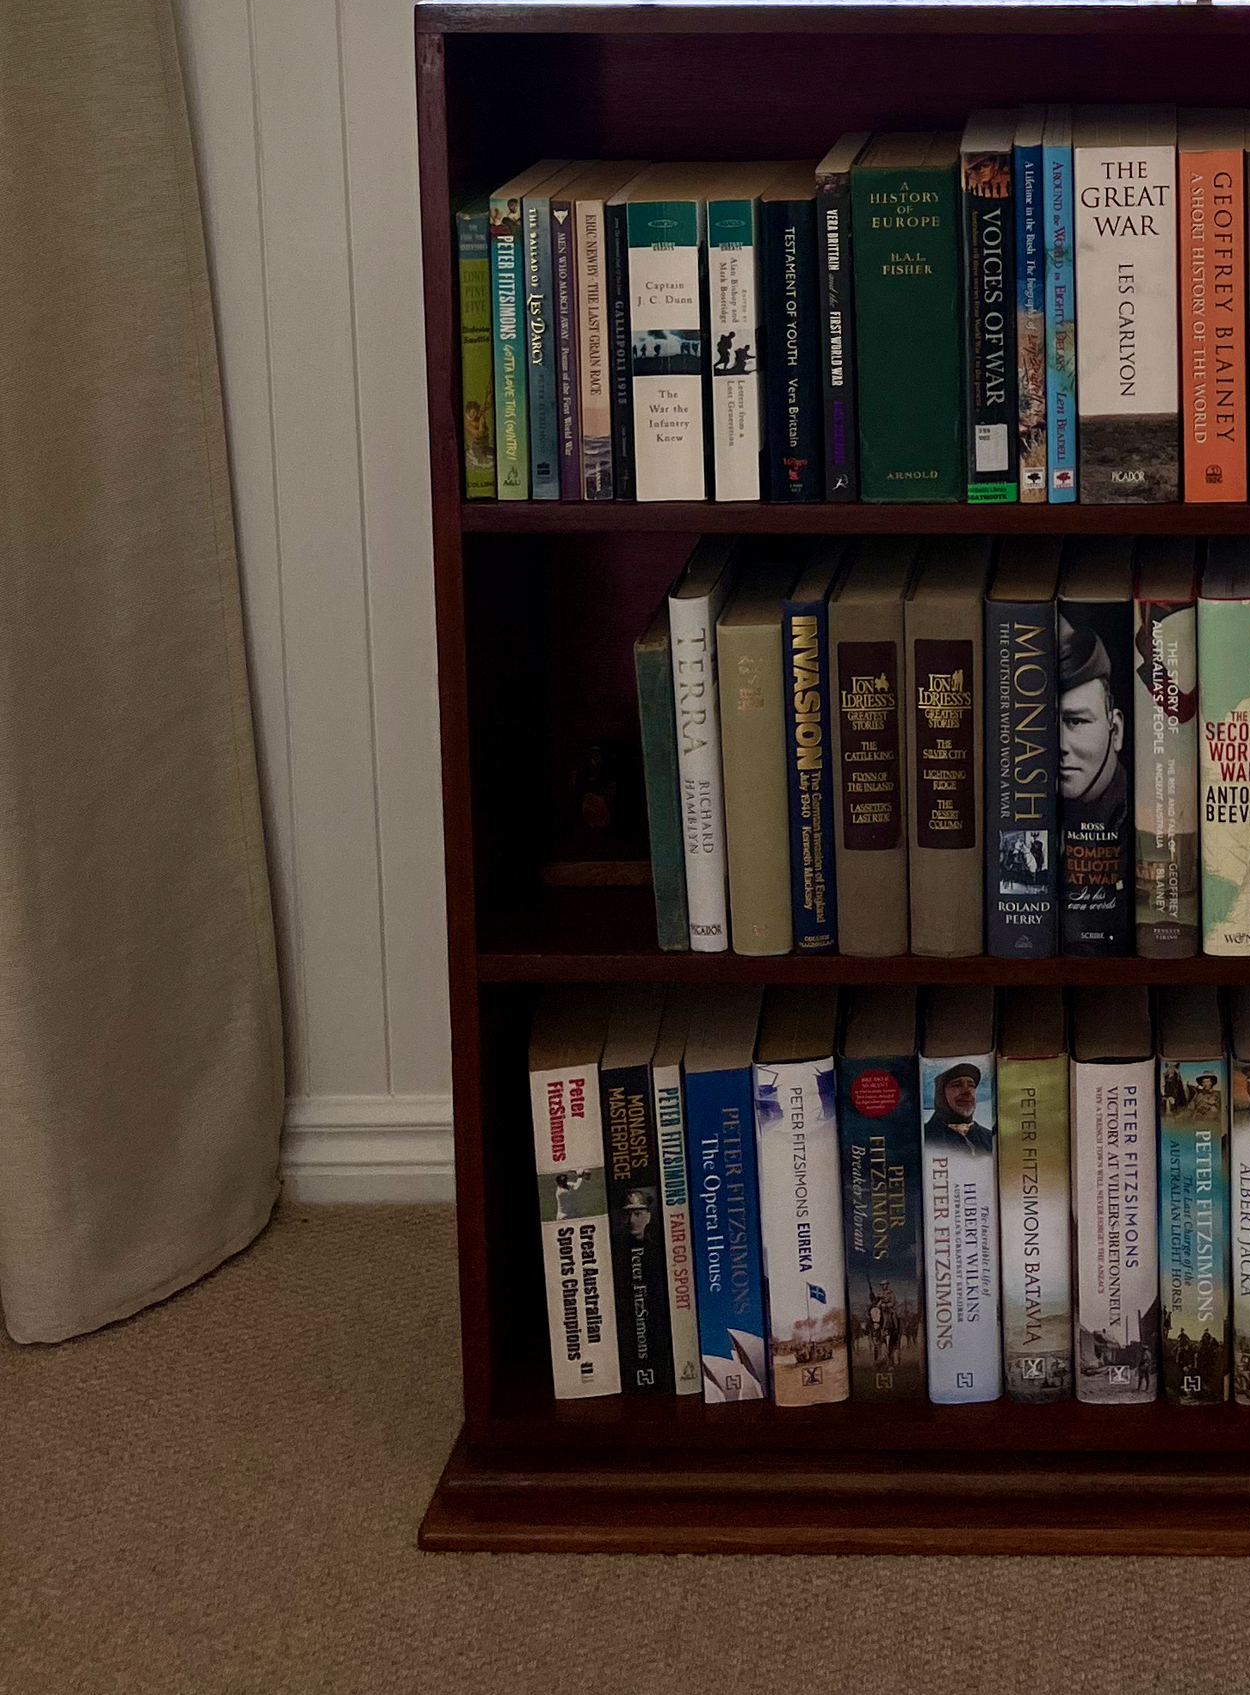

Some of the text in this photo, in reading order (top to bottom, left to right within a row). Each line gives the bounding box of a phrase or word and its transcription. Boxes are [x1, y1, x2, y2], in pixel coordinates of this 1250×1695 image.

[870, 191, 939, 205] HISTORY
[897, 205, 913, 215] OF
[1081, 186, 1170, 208] GREAT
[1101, 162, 1147, 179] THE
[871, 215, 940, 229] EUROPE
[1093, 217, 1159, 236] WAR
[497, 236, 516, 340] PETER FITZSIMONS
[645, 280, 685, 292] Captain
[784, 227, 798, 366] TESTAMENT OF YOUTH
[882, 263, 932, 276] FISHER
[982, 208, 1006, 407] VOICES OF WAR
[1190, 173, 1207, 444] A SHORT HISTORY OF THE WORLD
[1213, 172, 1235, 443] GEOFFREY BLAINEY
[1118, 263, 1136, 397] LES CARLYON
[649, 404, 688, 414] War the
[649, 418, 690, 430] Infantry
[656, 432, 684, 443] Knew
[658, 389, 677, 400] The
[788, 378, 798, 447] Vera Brittain
[677, 628, 708, 757] TERRA
[791, 615, 823, 770] INVASION
[999, 622, 1011, 818] THE OUTSIDER WHO WON A WAR
[1013, 622, 1048, 822] MONASH
[1152, 620, 1164, 754] AUSTRALIA'S PEOPLE
[1167, 641, 1179, 734] THE STORY OF
[1231, 711, 1248, 722] THE
[685, 780, 699, 854] HAMBLYN
[699, 782, 714, 854] RICHARD
[1156, 868, 1165, 913] BLAINEY
[1168, 863, 1178, 917] GEOFFREY
[547, 1081, 567, 1162] FitzSimons
[569, 1078, 585, 1118] Peter
[700, 1133, 723, 1292] The Opera House
[790, 1087, 813, 1272] PETER FITZSIMONS EUREKA
[1021, 1088, 1040, 1346] PETER FITZSIMONS BATAVIA
[1124, 1086, 1139, 1269] PETER FITZSIMONS
[931, 1157, 953, 1350] PETER FITZSIMONS
[962, 1183, 980, 1322] HUBERT WILKINS
[1195, 1130, 1215, 1322] PETER FITZSIMONS
[558, 1227, 582, 1361] Sports Champions
[580, 1224, 602, 1344] Great Australian
